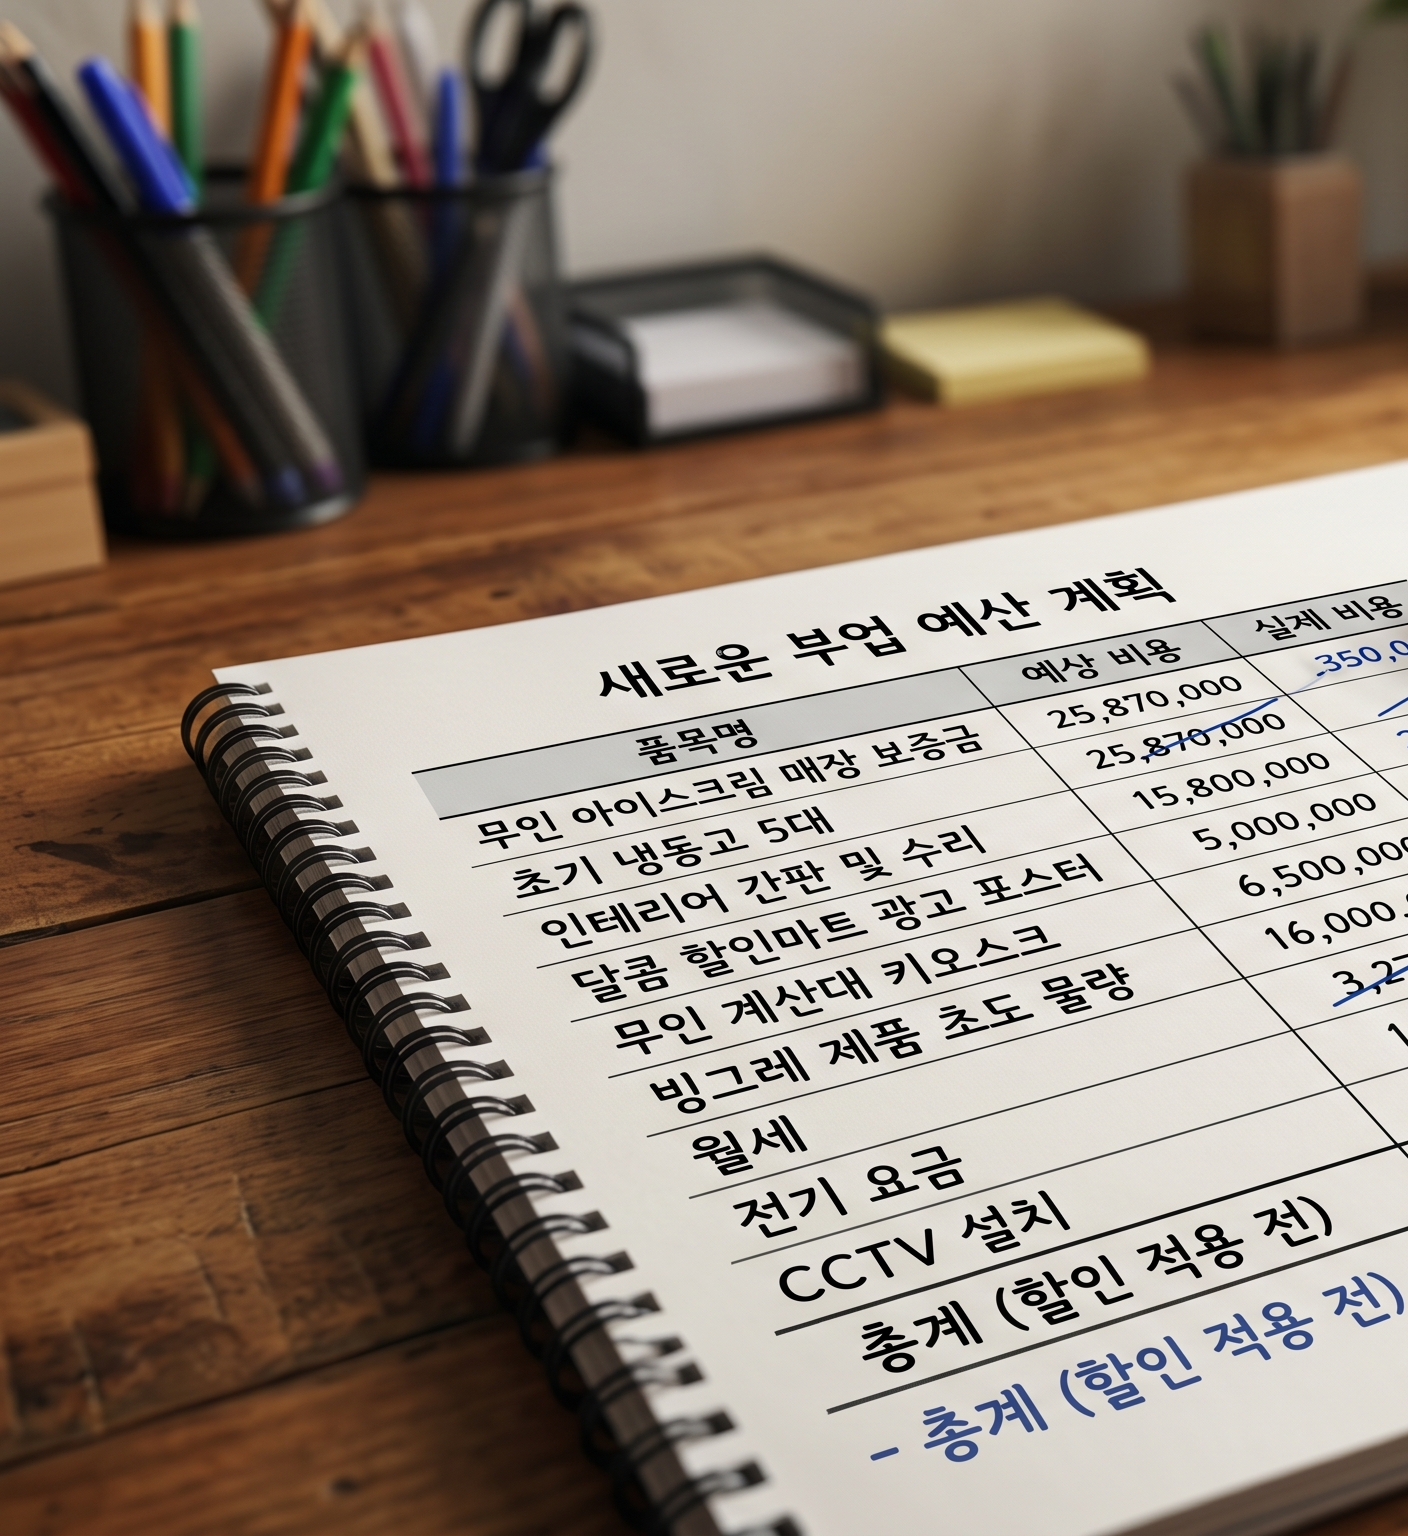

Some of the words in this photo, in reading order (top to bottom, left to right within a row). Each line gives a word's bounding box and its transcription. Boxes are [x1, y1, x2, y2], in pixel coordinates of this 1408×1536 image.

[600, 644, 772, 698] 새로운
[787, 616, 906, 666] 부업
[917, 592, 1041, 636] 예산
[1048, 568, 1176, 611] 계획
[1022, 654, 1098, 683] 예상
[1107, 639, 1181, 666] 비용
[1256, 609, 1331, 641] 실제
[1331, 596, 1402, 620] 비용
[636, 719, 757, 765] 품목명
[1047, 675, 1241, 728] 25,870,000
[1086, 714, 1288, 770] 25,870,000
[478, 811, 563, 849] 무인
[572, 768, 773, 827] 아이스크림
[779, 749, 860, 783] 매장
[872, 725, 982, 767] 보증금
[1133, 753, 1329, 809] 15,800,000
[1191, 794, 1376, 850] 5,000,000
[513, 856, 603, 898] 초기
[613, 829, 749, 875] 냉동고
[757, 806, 834, 842] 5대
[541, 884, 729, 950] 인테리어
[737, 861, 831, 904] 간판
[839, 847, 892, 881] 및
[903, 825, 986, 868] 수리
[571, 955, 668, 1003] 달콤
[680, 912, 868, 978] 할인마트
[877, 889, 967, 930] 광고
[973, 853, 1103, 905] 포스터
[614, 1006, 713, 1054] 무인
[721, 967, 873, 1024] 계산대
[881, 924, 1061, 984] 키오스크
[650, 1046, 810, 1114] 빙그레
[819, 1018, 922, 1064] 제품
[939, 994, 1034, 1040] 초도
[1041, 963, 1133, 1014] 물량
[693, 1115, 807, 1176] 월세
[733, 1177, 847, 1238] 전기
[867, 1146, 964, 1202] 요금
[779, 1229, 934, 1302] CCTV
[962, 1191, 1070, 1253] 설치
[862, 1301, 983, 1373] 총계
[996, 1255, 1134, 1331] (할인
[1136, 1224, 1244, 1278] 적용
[1253, 1196, 1332, 1247] 전)
[923, 1384, 1048, 1462] 총계
[1060, 1336, 1201, 1417] (할인
[1203, 1302, 1313, 1360] 적용
[1322, 1272, 1404, 1327] 전)
